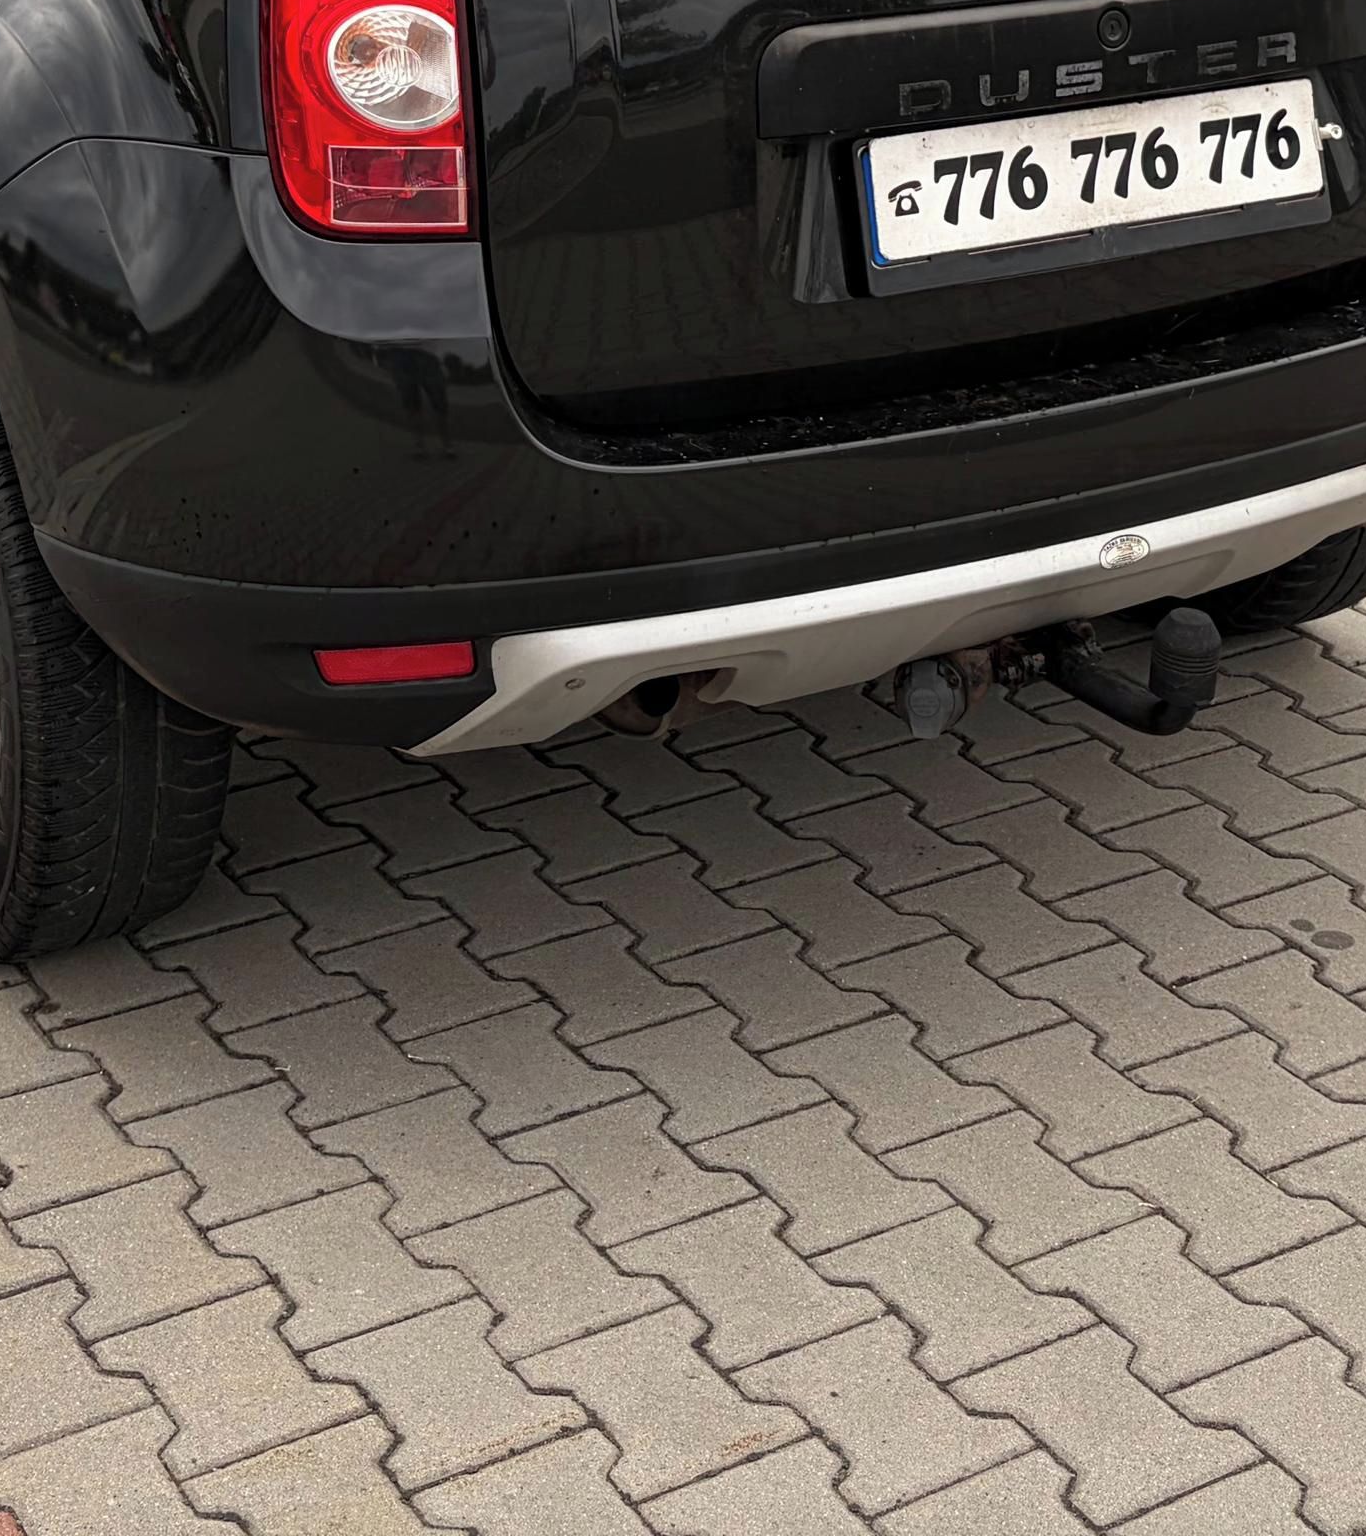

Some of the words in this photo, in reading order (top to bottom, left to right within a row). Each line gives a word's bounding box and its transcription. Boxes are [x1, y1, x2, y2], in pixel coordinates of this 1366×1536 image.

[898, 31, 1298, 117] DUSTER
[934, 145, 1049, 227] 776
[1071, 126, 1179, 205] 776
[1200, 108, 1301, 185] 776
